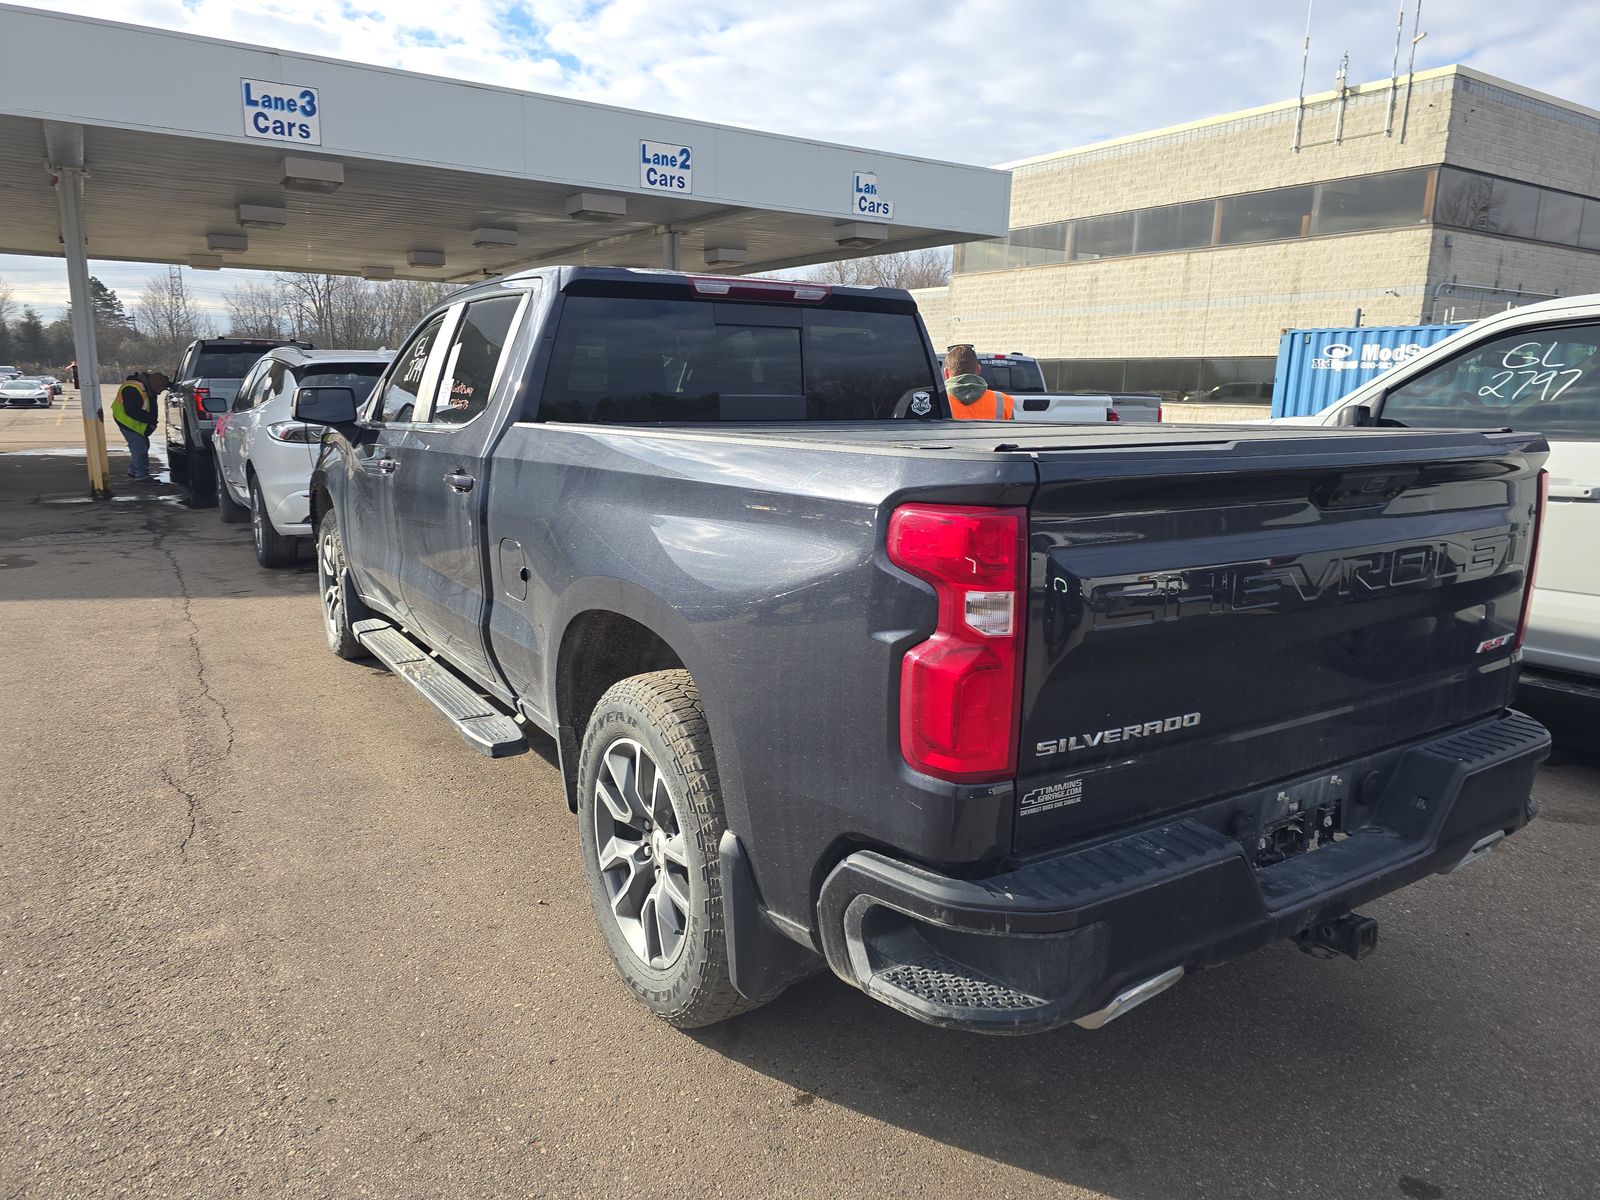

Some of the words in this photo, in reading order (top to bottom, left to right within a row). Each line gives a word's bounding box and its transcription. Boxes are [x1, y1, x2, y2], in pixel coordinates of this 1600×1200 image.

[253, 111, 311, 139] Cars
[647, 167, 685, 189] Cars
[859, 196, 890, 214] Cars
[1361, 343, 1423, 361] ModS
[1502, 341, 1566, 369] GL
[1478, 369, 1583, 401] 2797
[1090, 523, 1527, 632] CHEVROLET
[1035, 712, 1202, 757] SILVERADO
[1037, 786, 1082, 803] GARAGE.COM
[1039, 779, 1082, 795] TIMMINS
